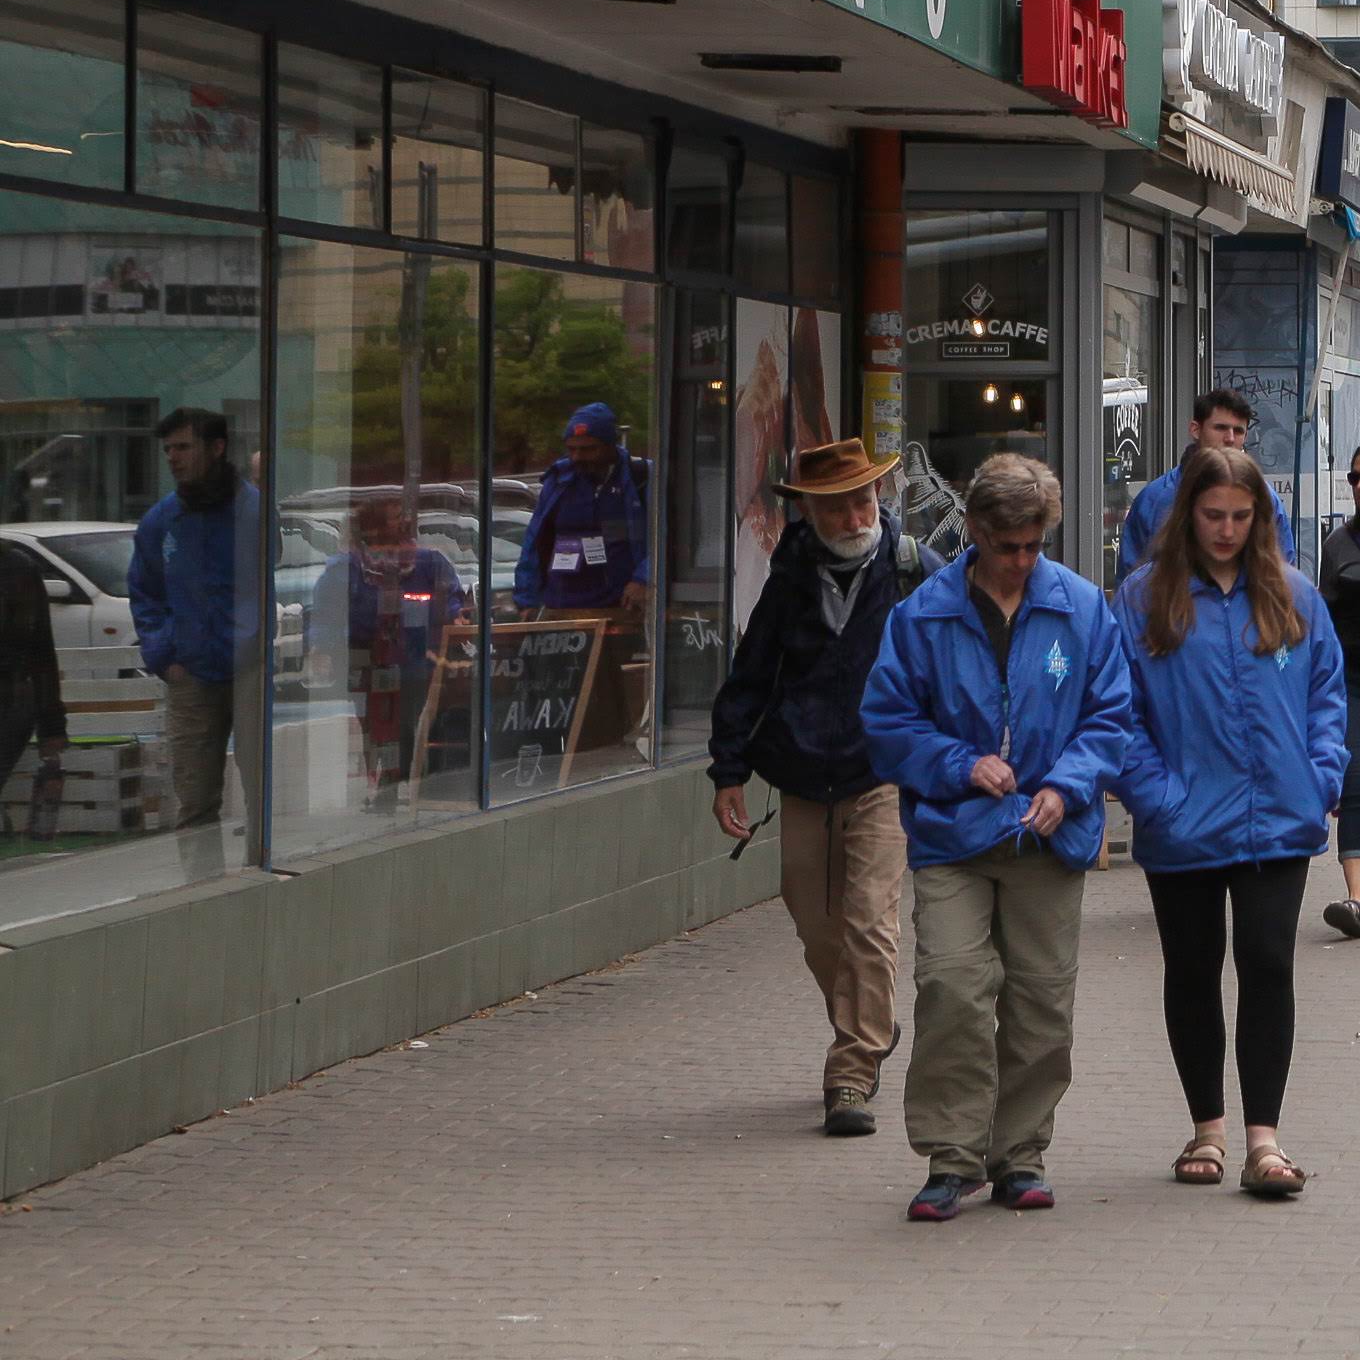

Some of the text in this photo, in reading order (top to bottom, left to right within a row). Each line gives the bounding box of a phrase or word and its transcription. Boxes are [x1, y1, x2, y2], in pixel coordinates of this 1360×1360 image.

[906, 319, 974, 344] CREMA
[987, 319, 1049, 345] CAFFE
[948, 345, 1005, 354] COFFEE SHOP
